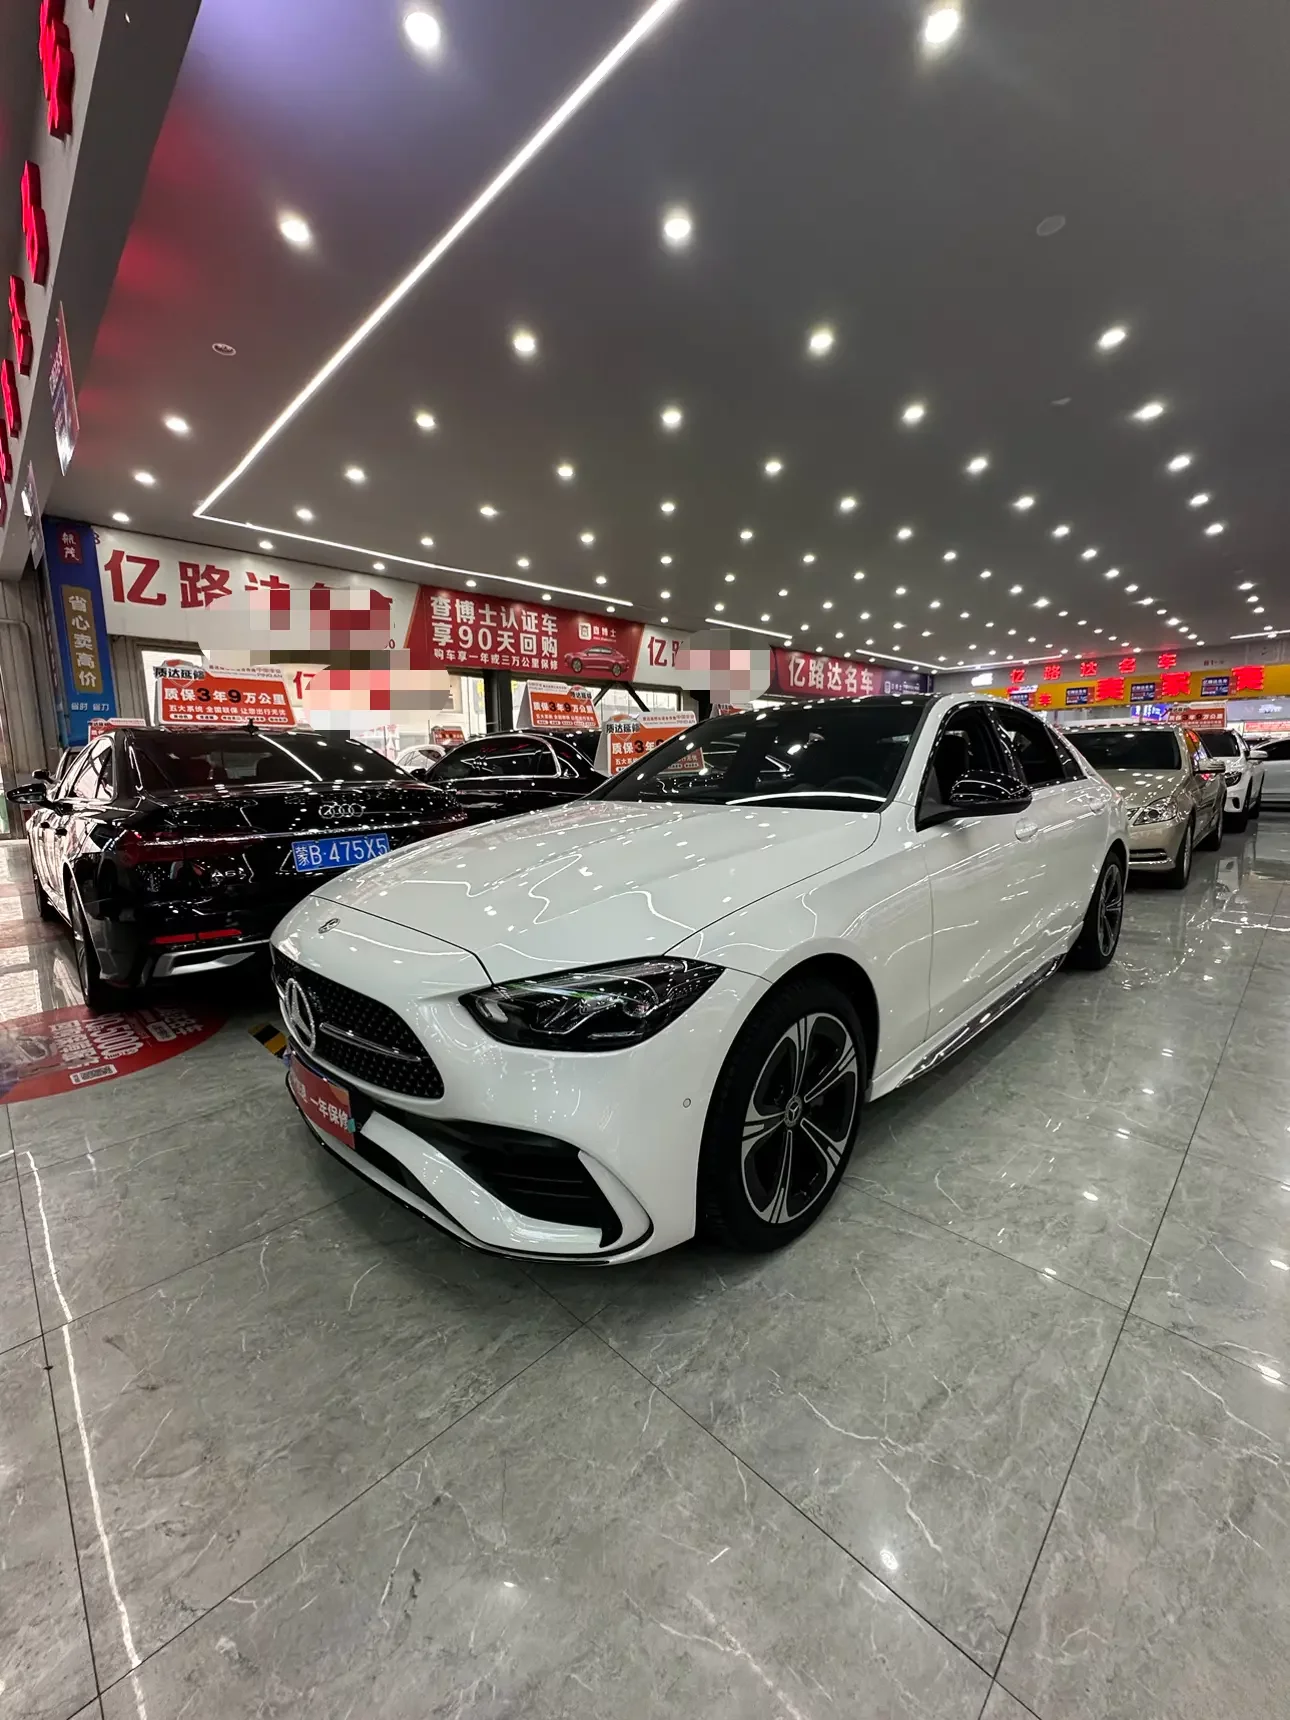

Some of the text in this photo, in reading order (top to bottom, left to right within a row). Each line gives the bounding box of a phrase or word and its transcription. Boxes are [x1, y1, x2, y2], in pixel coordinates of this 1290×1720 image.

[431, 596, 558, 635] 查博士认证车
[431, 622, 558, 658] 享90天回购
[788, 655, 874, 694] 亿路达名车
[164, 687, 287, 705] 质保3年9万公里
